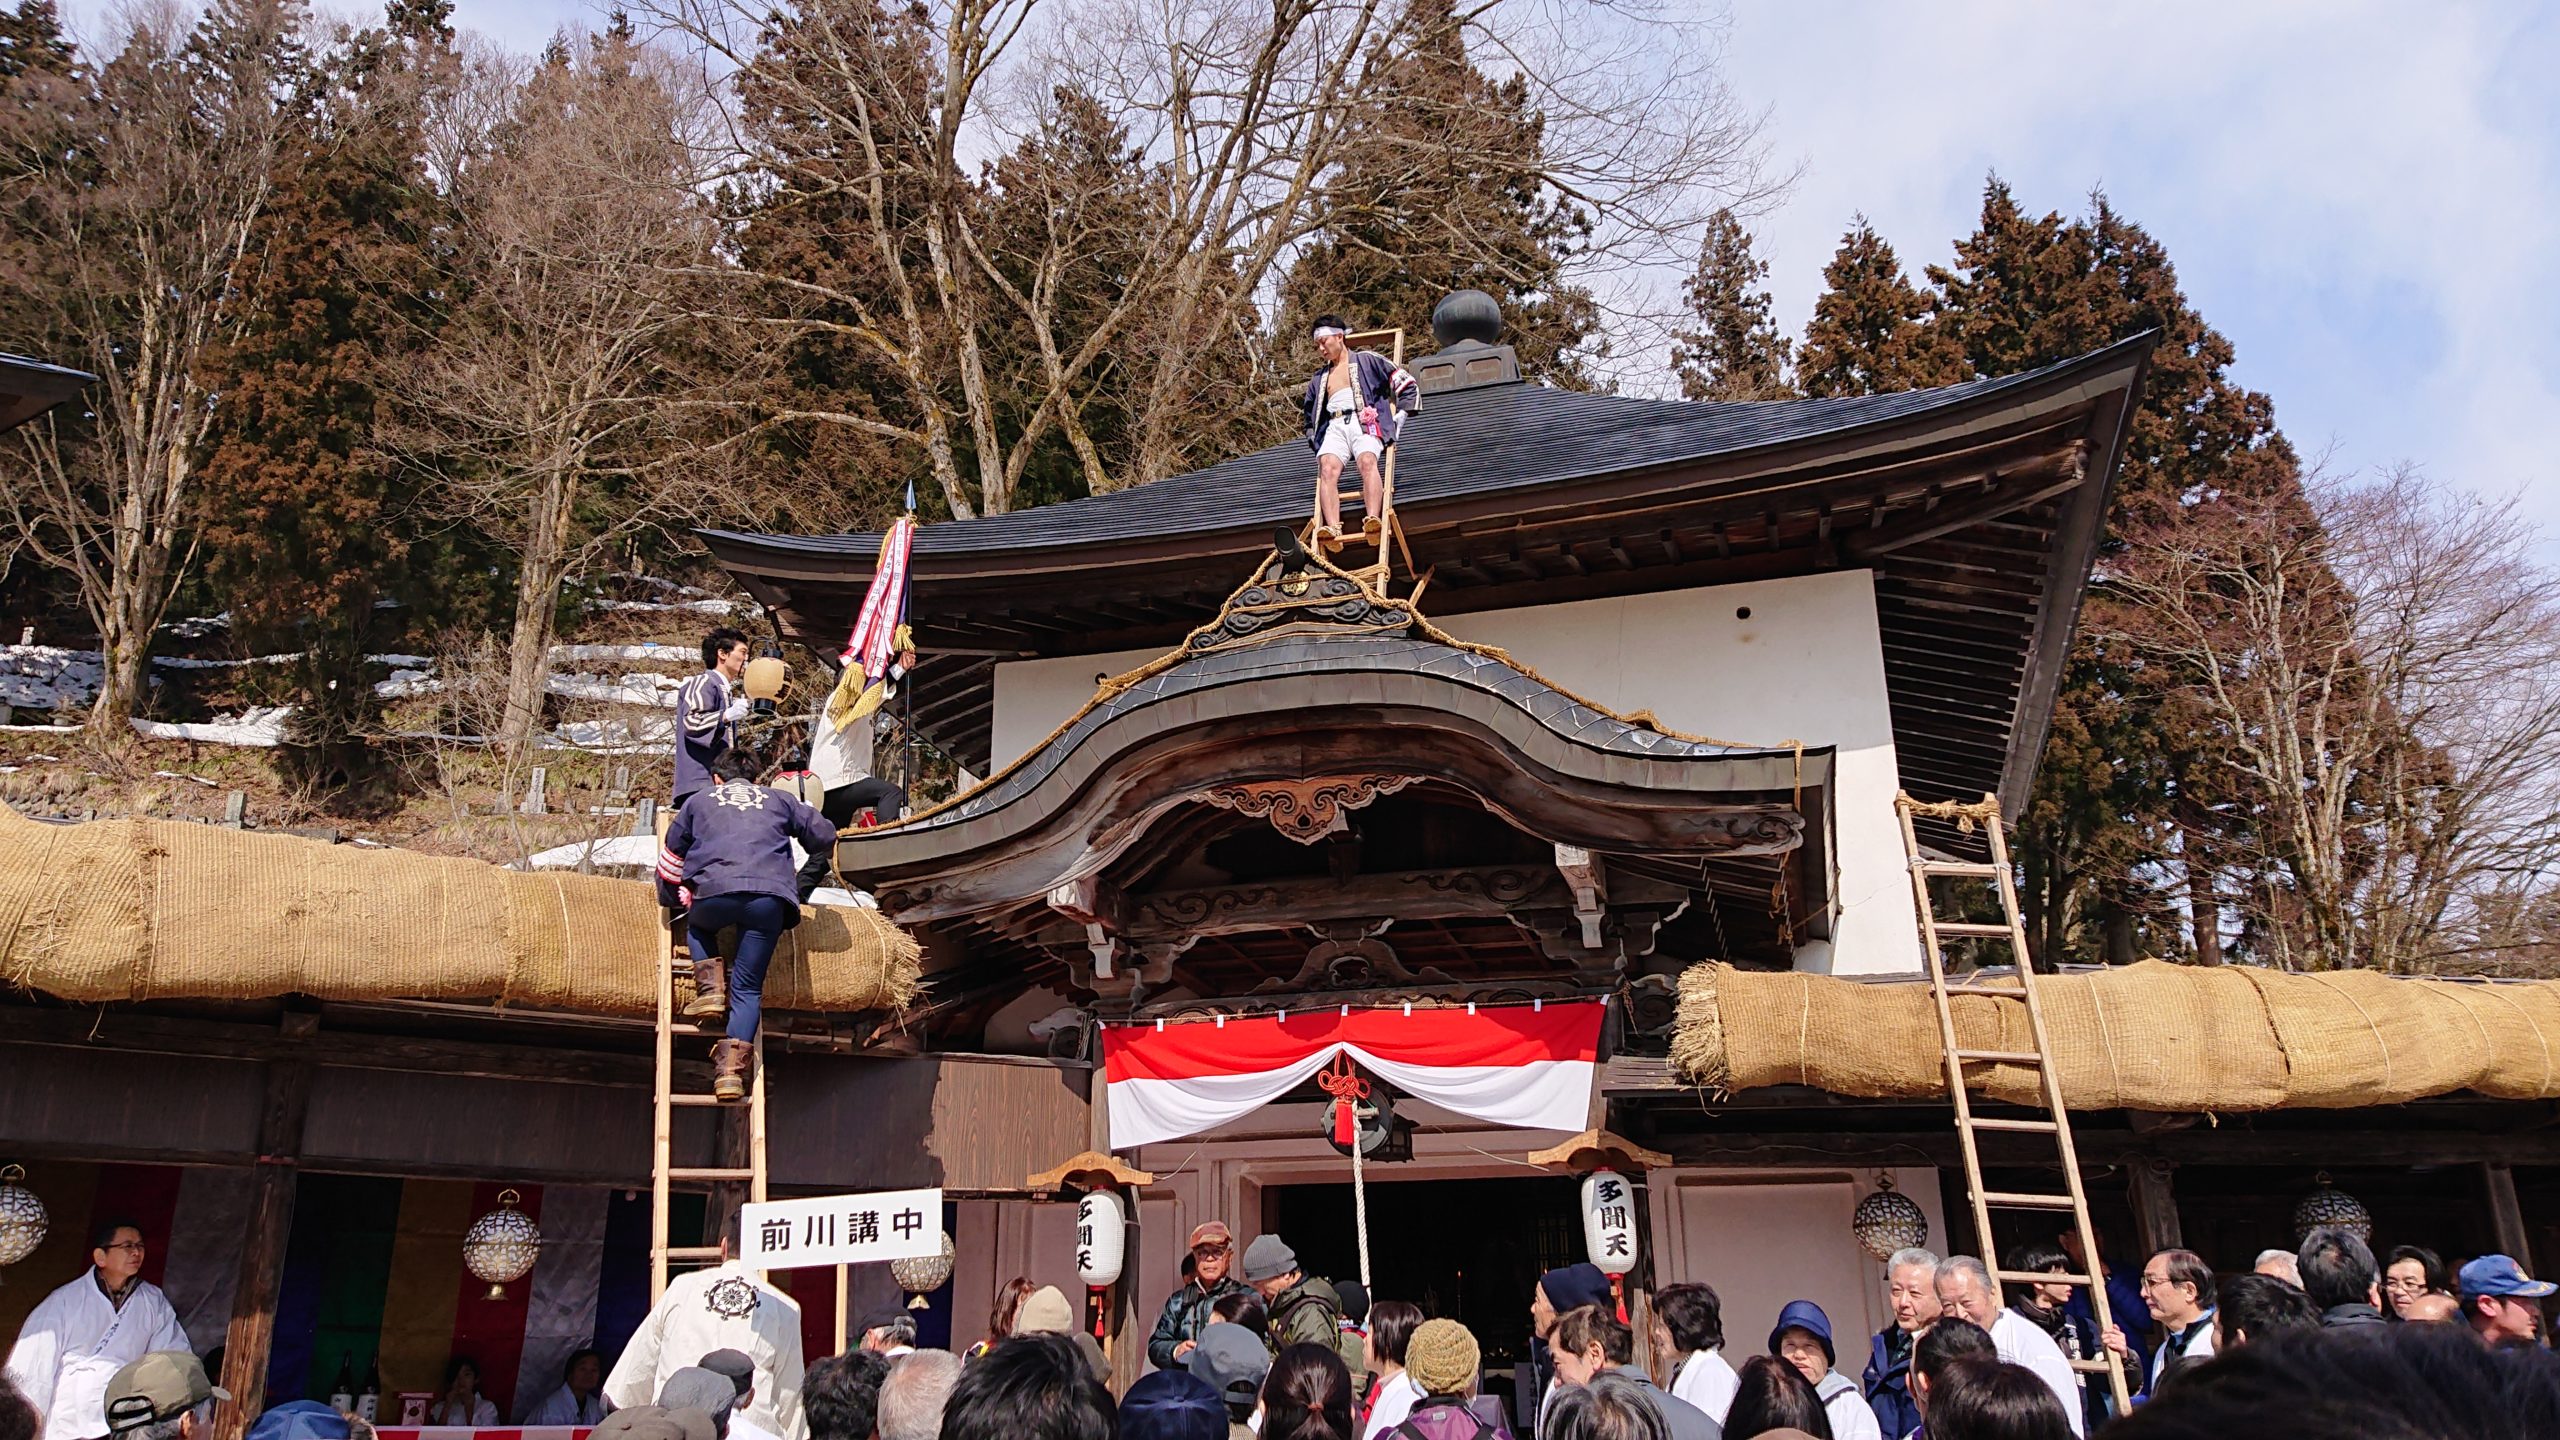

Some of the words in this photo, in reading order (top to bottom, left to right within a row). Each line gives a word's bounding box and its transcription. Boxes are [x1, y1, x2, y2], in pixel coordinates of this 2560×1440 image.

[760, 1206, 923, 1253] 前川講中
[1077, 1199, 1093, 1272] 多聞天
[1597, 1179, 1629, 1257] 多聞天
